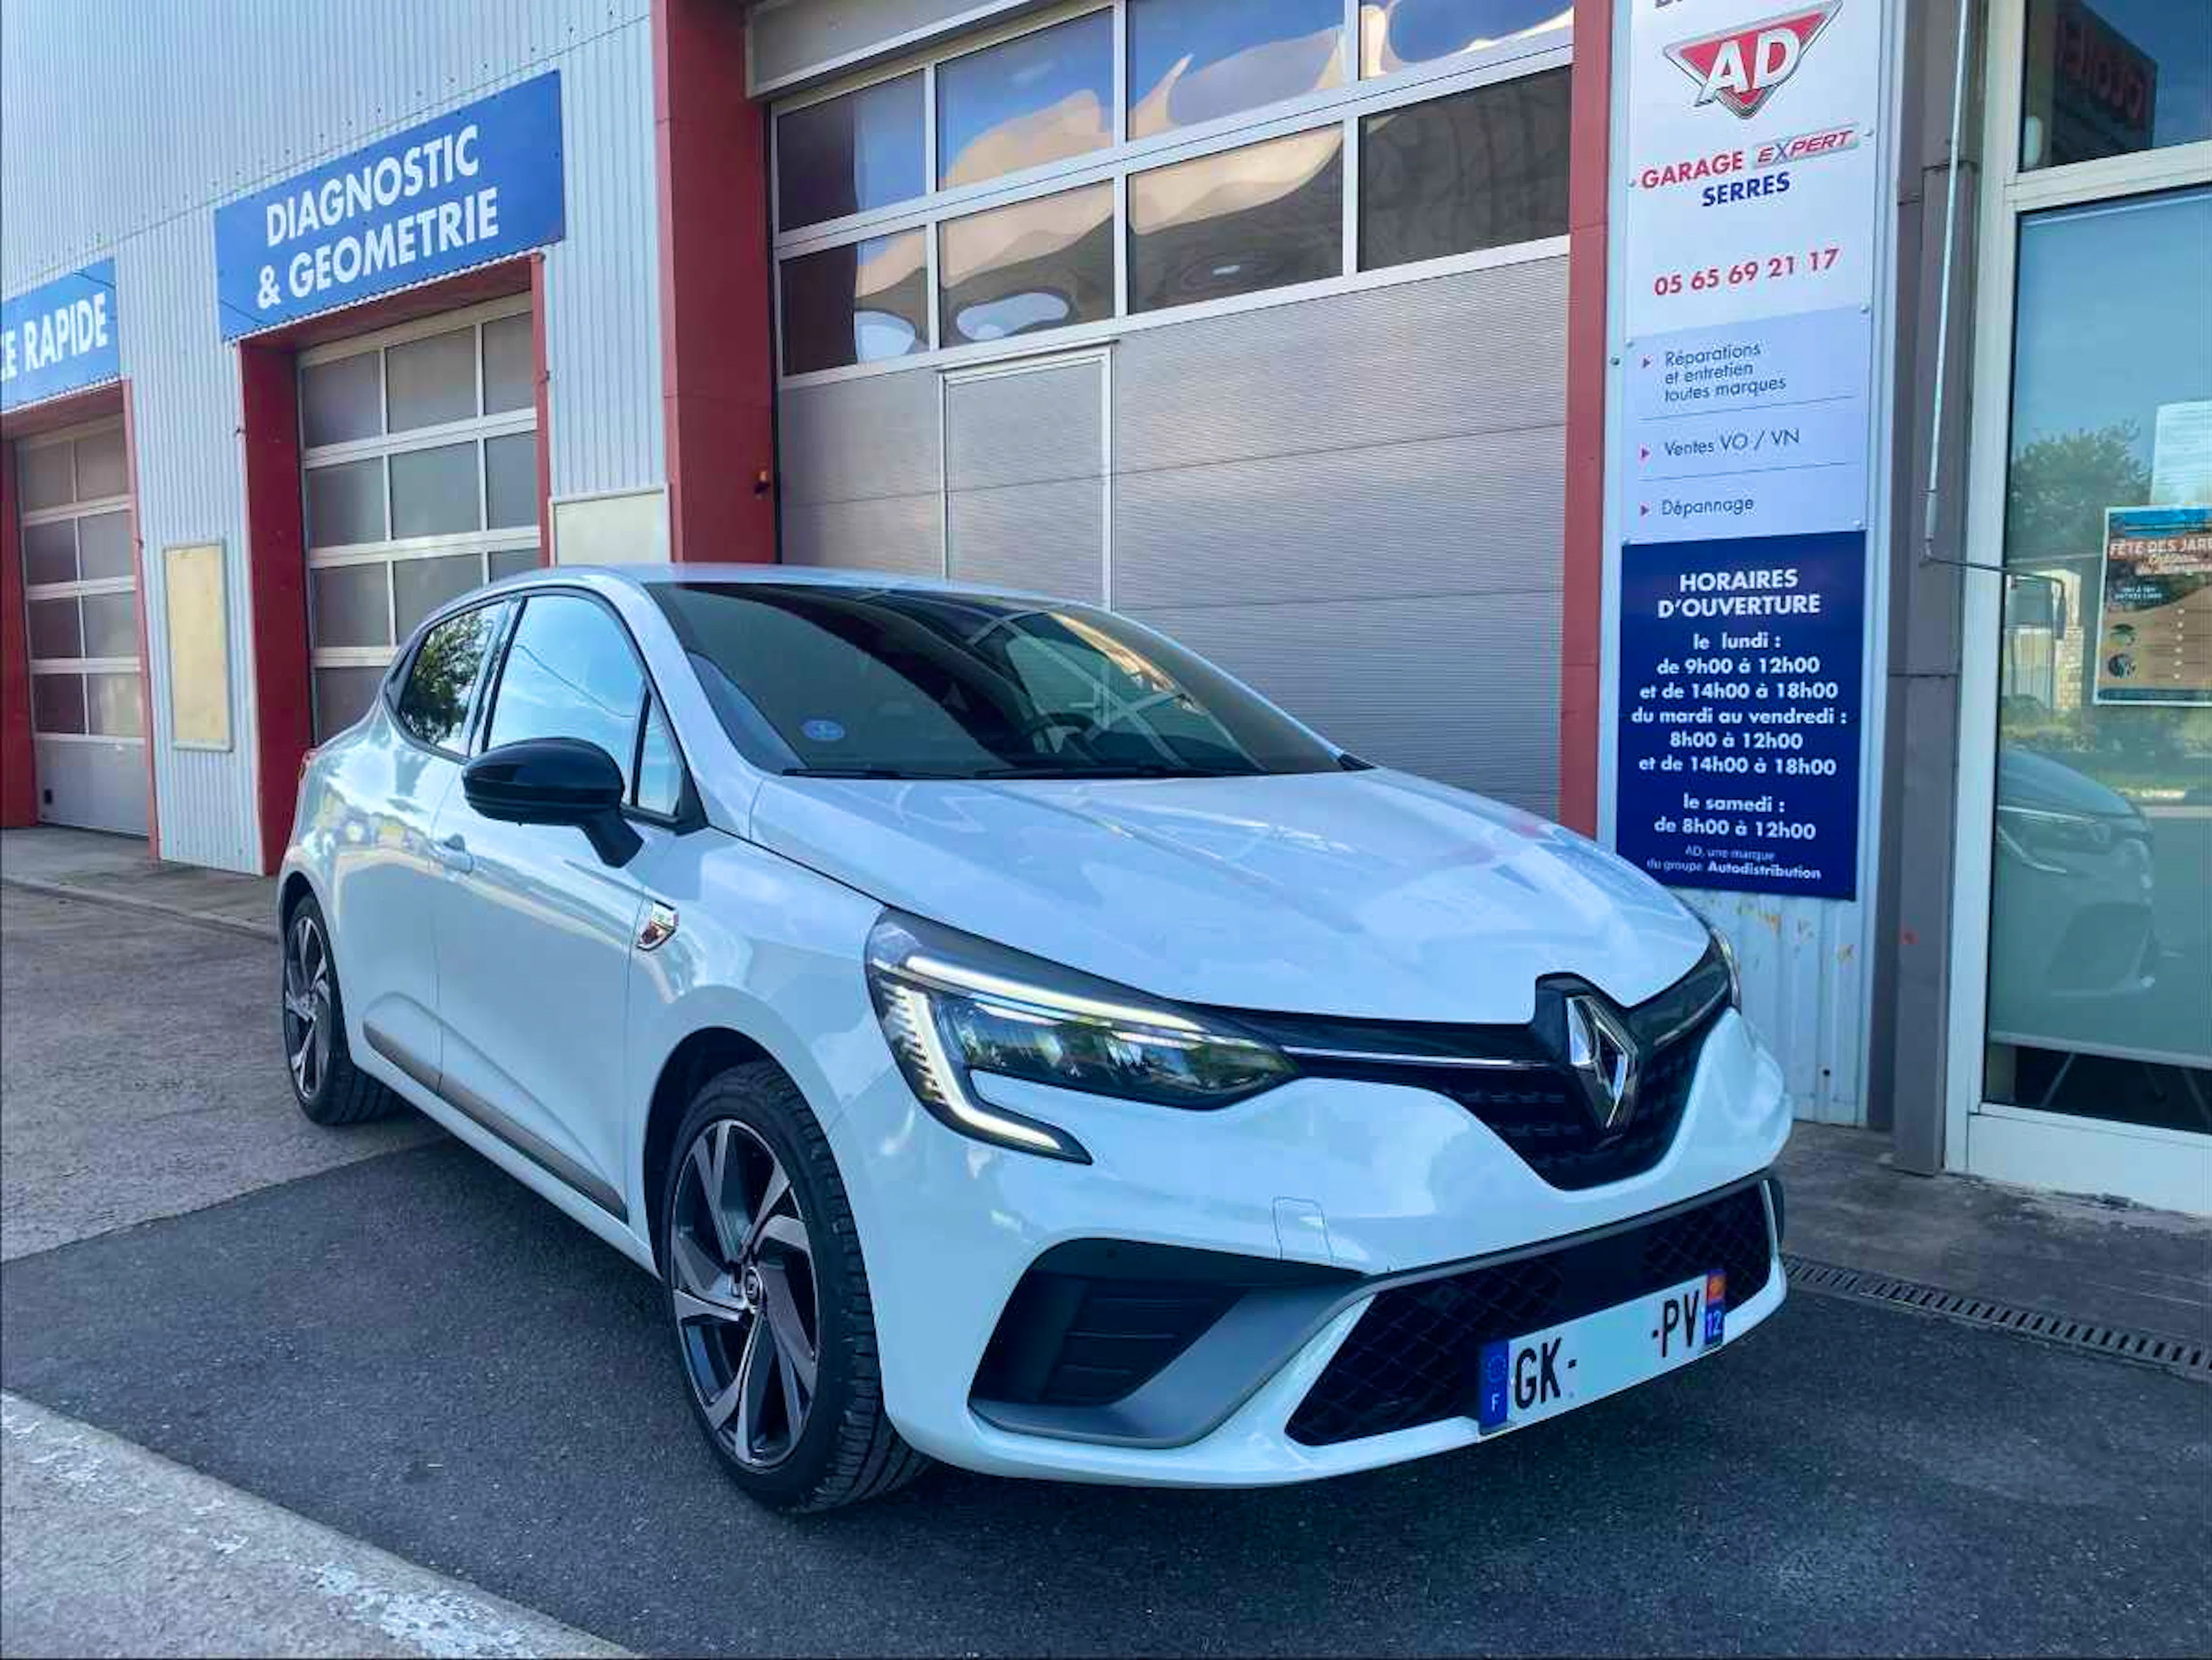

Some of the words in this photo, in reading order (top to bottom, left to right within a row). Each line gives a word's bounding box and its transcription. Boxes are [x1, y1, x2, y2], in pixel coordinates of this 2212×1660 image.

[1694, 28, 1801, 107] AD
[1642, 151, 1743, 189] GARAGE
[1757, 130, 1854, 164] EXPERT
[267, 125, 479, 247] DIAGNOSTIC
[1702, 172, 1790, 206] SERRES
[258, 264, 281, 309] &
[289, 188, 499, 299] GEOMETRIE
[1654, 274, 1682, 295] 05
[1691, 270, 1718, 290] 65
[1729, 262, 1758, 284] 69
[1768, 256, 1794, 278] 21
[1810, 249, 1839, 271] 17
[0, 329, 17, 382] E
[24, 290, 108, 372] RAPIDE
[1665, 343, 1761, 367] Réparations
[1665, 373, 1679, 385] et
[1684, 362, 1753, 382] entretien
[1665, 387, 1710, 402] toutes
[1715, 377, 1786, 396] marques
[1664, 440, 1714, 456] Ventes
[1719, 433, 1748, 451] VO
[1771, 429, 1800, 445] VN
[1661, 498, 1754, 517] Dépannage
[1680, 569, 1798, 593] HORAIRES
[1657, 594, 1821, 619] D'OUVERTURE
[1693, 633, 1710, 650] le
[1722, 631, 1768, 649] lundi
[1656, 658, 1680, 674] de
[1685, 658, 1733, 674] 9h00
[1738, 657, 1751, 674] à
[1758, 656, 1821, 674] 12h00
[1639, 684, 1656, 699] et
[1661, 683, 1684, 699] de
[1692, 683, 1750, 699] 14h00
[1756, 682, 1768, 699] à
[1777, 682, 1839, 699] 18h00
[1631, 707, 1654, 723] du
[1660, 707, 1714, 724] mardi
[1719, 712, 1743, 725] au
[1749, 707, 1835, 725] vendredi
[1669, 732, 1717, 748] 8h00
[1722, 732, 1735, 749] à
[1743, 732, 1804, 749] 12h00
[1638, 756, 1656, 771] et
[1661, 755, 1683, 772] de
[1690, 756, 1749, 774] 14h00
[1754, 757, 1767, 774] à
[1775, 758, 1837, 776] 18h00
[1683, 793, 1700, 810] le
[1705, 796, 1772, 813] samedi
[1654, 816, 1676, 833] de
[1681, 818, 1729, 835] 8h00
[1735, 820, 1748, 837] à
[1755, 821, 1817, 840] 12h00
[1707, 860, 1823, 880] Autodistribution
[1707, 1310, 1723, 1337] 12
[1491, 1393, 1499, 1412] F
